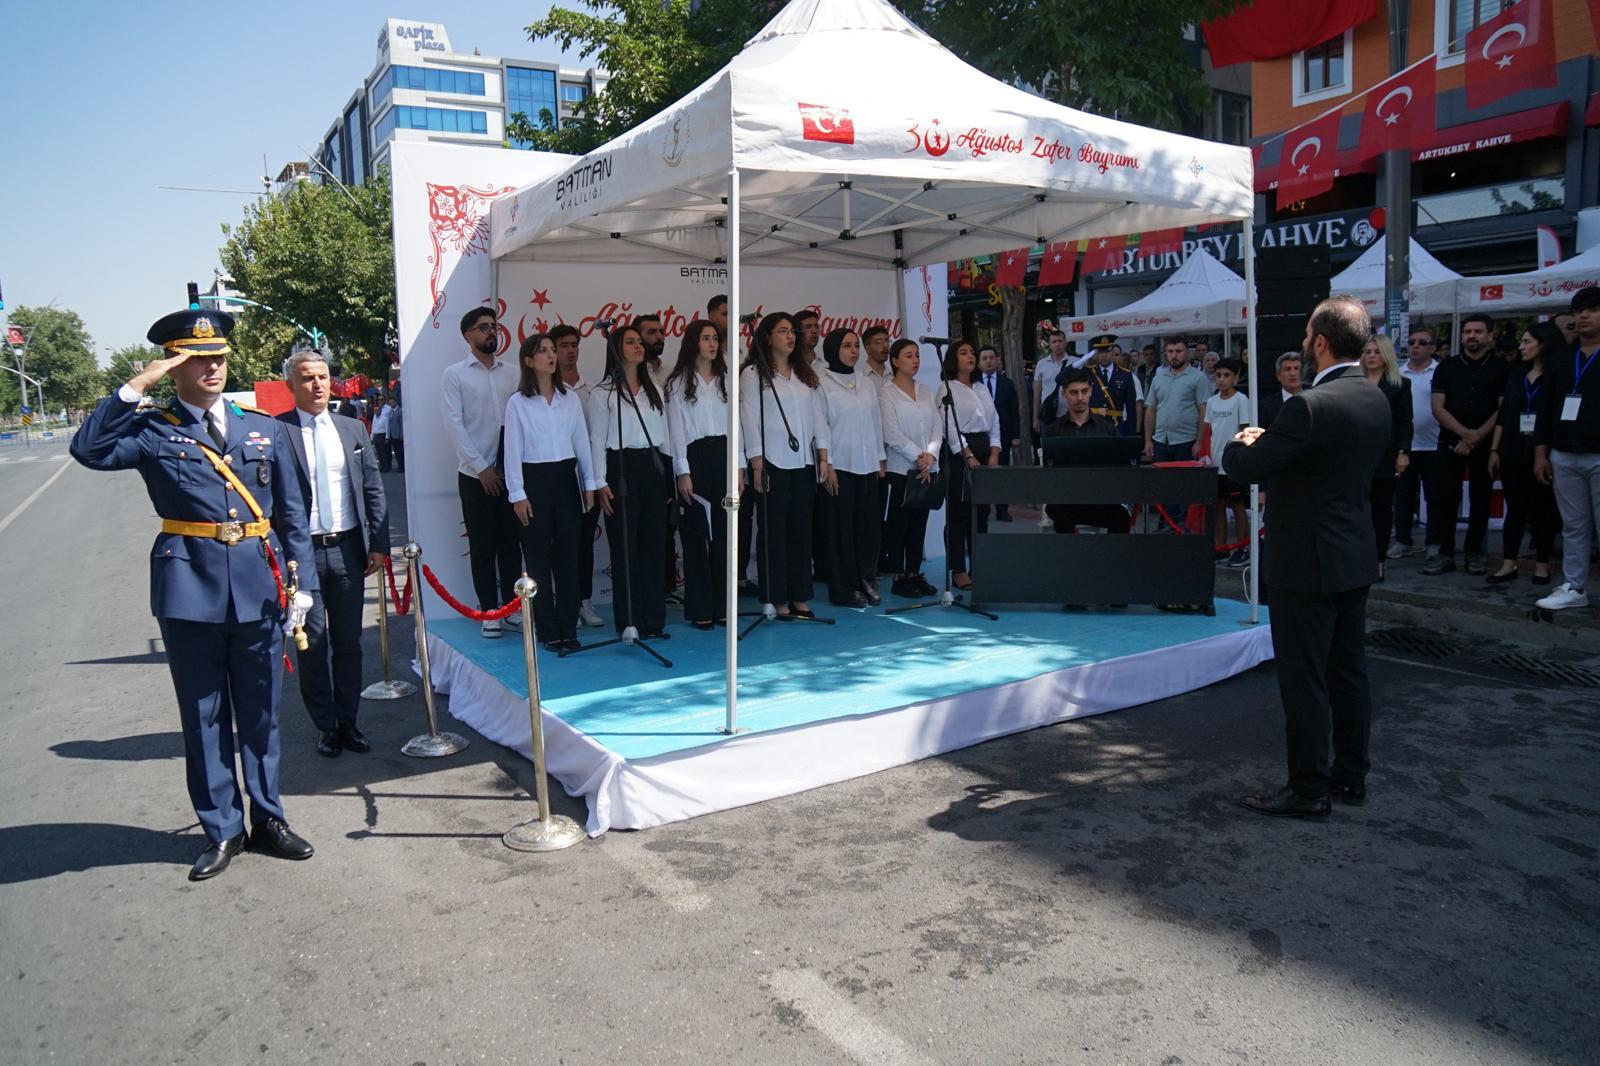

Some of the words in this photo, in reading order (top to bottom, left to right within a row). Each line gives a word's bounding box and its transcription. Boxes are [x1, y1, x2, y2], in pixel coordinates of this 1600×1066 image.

[956, 127, 1024, 158] Ağustos
[1031, 136, 1073, 164] Zafer
[1077, 142, 1140, 175] Bayramı
[1418, 142, 1471, 161] ARTUKBEY
[1475, 134, 1512, 150] KAHVE
[556, 154, 612, 201] BATMAN
[680, 267, 728, 278] BATMA
